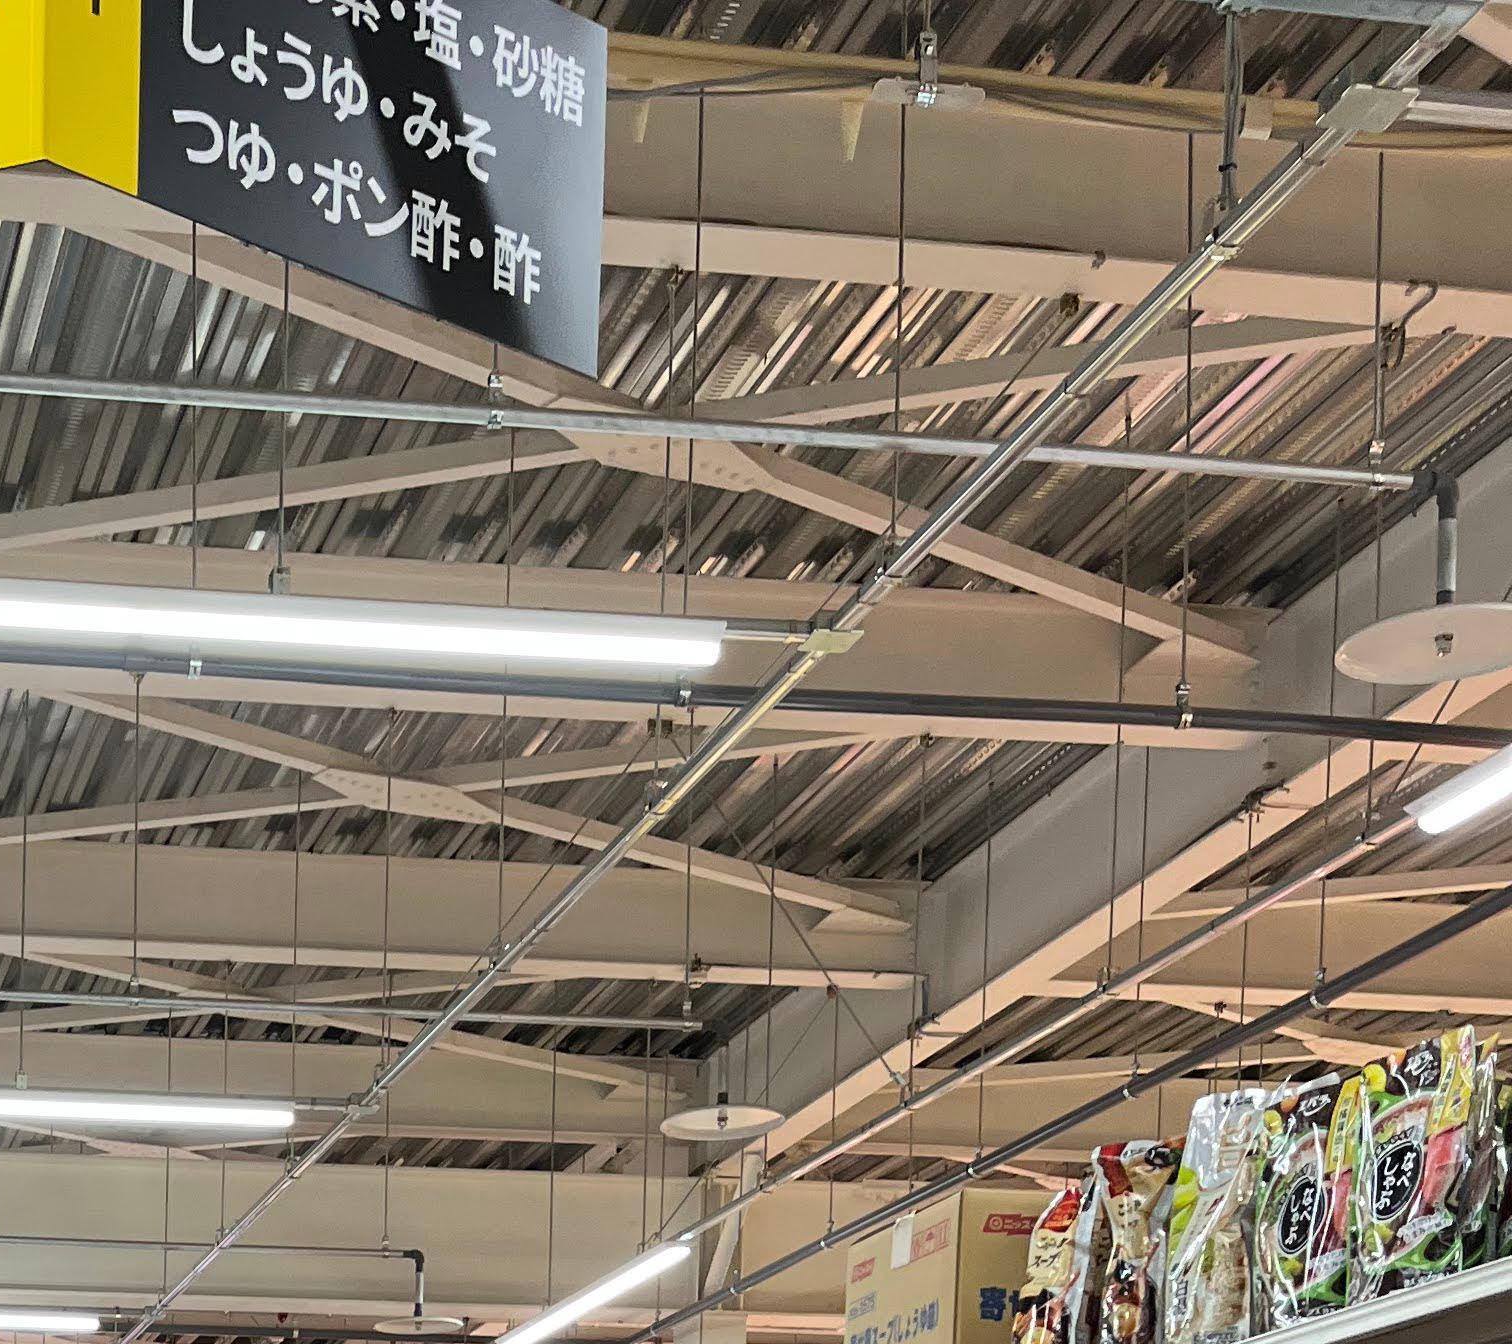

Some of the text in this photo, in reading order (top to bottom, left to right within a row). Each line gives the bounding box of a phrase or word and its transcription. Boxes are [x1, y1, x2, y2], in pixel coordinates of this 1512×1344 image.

[183, 0, 497, 183] しょうゆ・みそ
[171, 105, 541, 304] つゆ・ポン酢・酢
